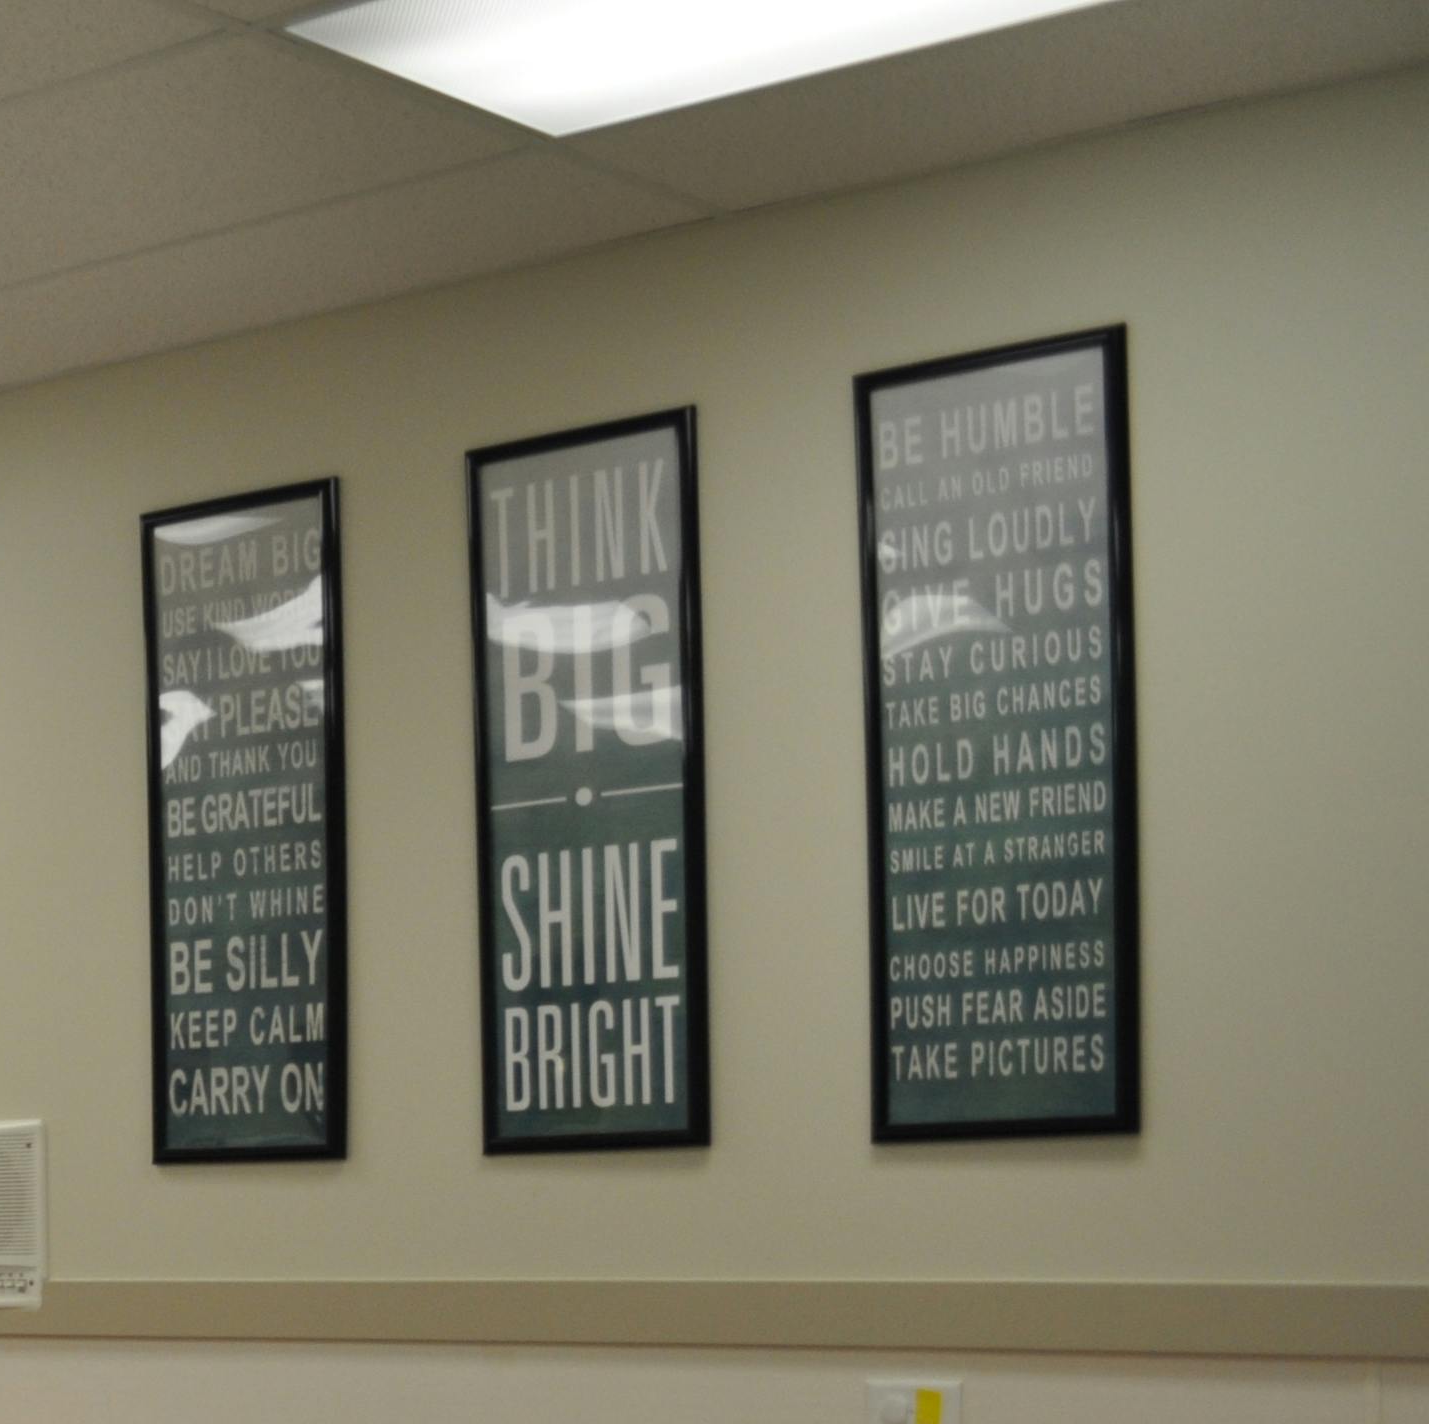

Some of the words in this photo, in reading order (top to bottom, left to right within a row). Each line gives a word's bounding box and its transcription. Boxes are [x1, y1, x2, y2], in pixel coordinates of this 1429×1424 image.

[880, 416, 923, 470] BE
[941, 384, 1094, 459] HUMBLE
[881, 480, 928, 512] CALL
[940, 475, 962, 500] AN
[972, 467, 1010, 495] OLD
[1020, 452, 1092, 488] FRIEND
[491, 458, 668, 599] THINK
[879, 521, 953, 573] SING
[968, 497, 1096, 560] LOUDLY
[159, 538, 258, 595] DREAM
[273, 528, 322, 577] BIG
[162, 606, 196, 638] USE
[203, 597, 245, 631] KIND
[882, 578, 970, 635] GIVE
[996, 559, 1102, 618] HUGS
[163, 652, 201, 687] SAY
[206, 647, 212, 681] I
[502, 593, 671, 762] BIG
[883, 646, 952, 686] STAY
[970, 625, 1102, 675] CURIOUS
[220, 683, 321, 738] PLEASE
[886, 696, 939, 729] TAKE
[949, 690, 986, 722] BIG
[996, 675, 1101, 715] CHANCES
[165, 755, 201, 785] AND
[209, 745, 270, 778] THANK
[277, 738, 316, 771] YOU
[888, 738, 974, 787] HOLD
[994, 722, 1106, 776] HANDS
[167, 797, 196, 837] BE
[201, 783, 322, 834] GRATEFUL
[888, 797, 945, 832] MAKE
[953, 796, 967, 826] A
[975, 789, 1020, 824] NEW
[1029, 780, 1107, 818] FRIEND
[168, 851, 222, 882] HELP
[233, 840, 322, 876] OTHERS
[891, 846, 943, 874] SMILE
[953, 842, 975, 867] AT
[983, 840, 995, 865] A
[1004, 829, 1105, 863] STRANGER
[168, 892, 237, 926] DON'T
[249, 884, 324, 919] WHINE
[501, 838, 680, 992] SHINE
[892, 891, 946, 931] LIVE
[956, 886, 1006, 926] FOR
[1017, 878, 1103, 921] TODAY
[169, 939, 213, 995] BE
[226, 929, 323, 992] SILLY
[890, 950, 974, 982] CHOOSE
[984, 940, 1105, 976] HAPPINESS
[170, 1008, 237, 1050] KEEP
[250, 1002, 324, 1045] CALM
[891, 994, 951, 1030] PUSH
[962, 989, 1023, 1026] FEAR
[1033, 983, 1106, 1021] ASIDE
[505, 995, 680, 1112] BRIGHT
[891, 1042, 958, 1082] TAKE
[971, 1034, 1105, 1078] PICTURES
[169, 1064, 270, 1117] CARRY
[281, 1062, 324, 1113] ON
